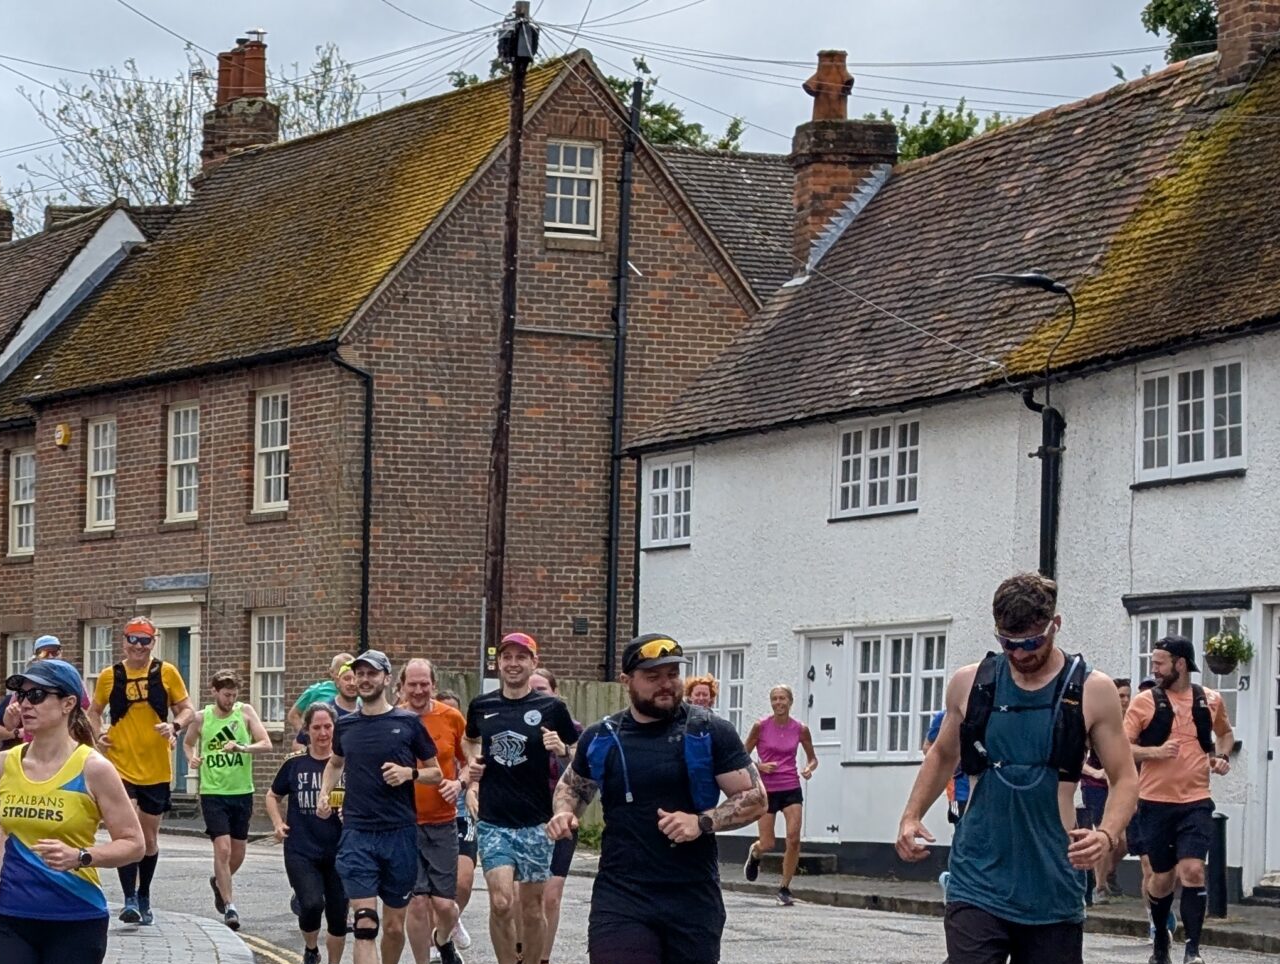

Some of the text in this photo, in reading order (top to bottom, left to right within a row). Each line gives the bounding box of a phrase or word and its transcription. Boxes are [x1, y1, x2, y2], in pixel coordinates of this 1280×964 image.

[206, 752, 244, 769] BBVA
[5, 794, 65, 809] ST ALBANS
[1, 806, 64, 822] STRIDERS
